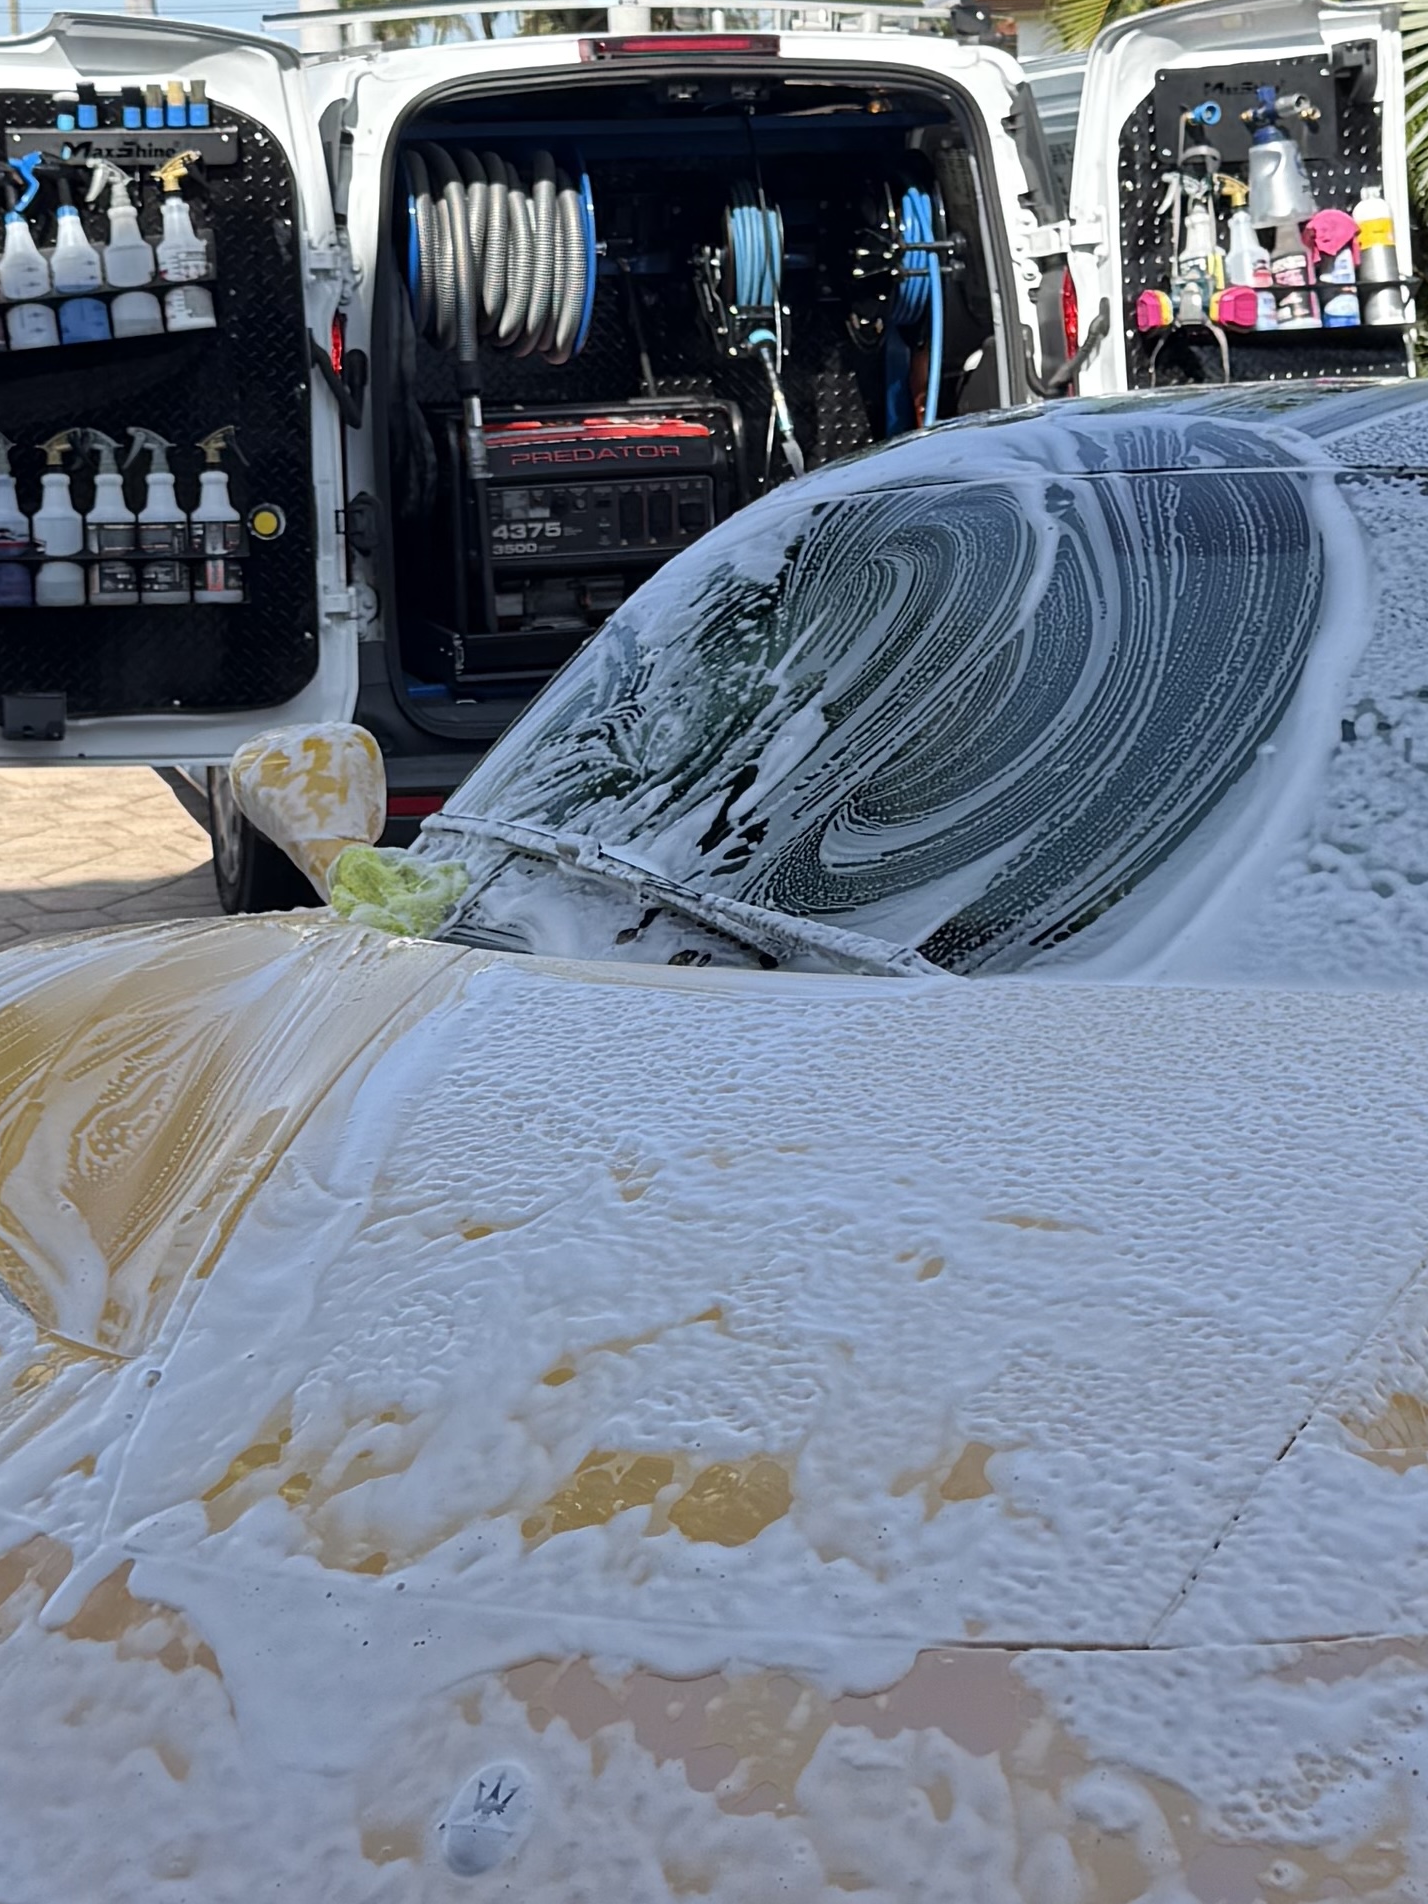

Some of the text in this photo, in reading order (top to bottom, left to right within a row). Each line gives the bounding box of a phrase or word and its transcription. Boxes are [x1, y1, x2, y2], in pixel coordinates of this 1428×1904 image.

[62, 140, 177, 159] MaxShine
[511, 445, 681, 465] PREDATOR
[492, 521, 562, 540] 4375
[492, 543, 538, 555] 3500
